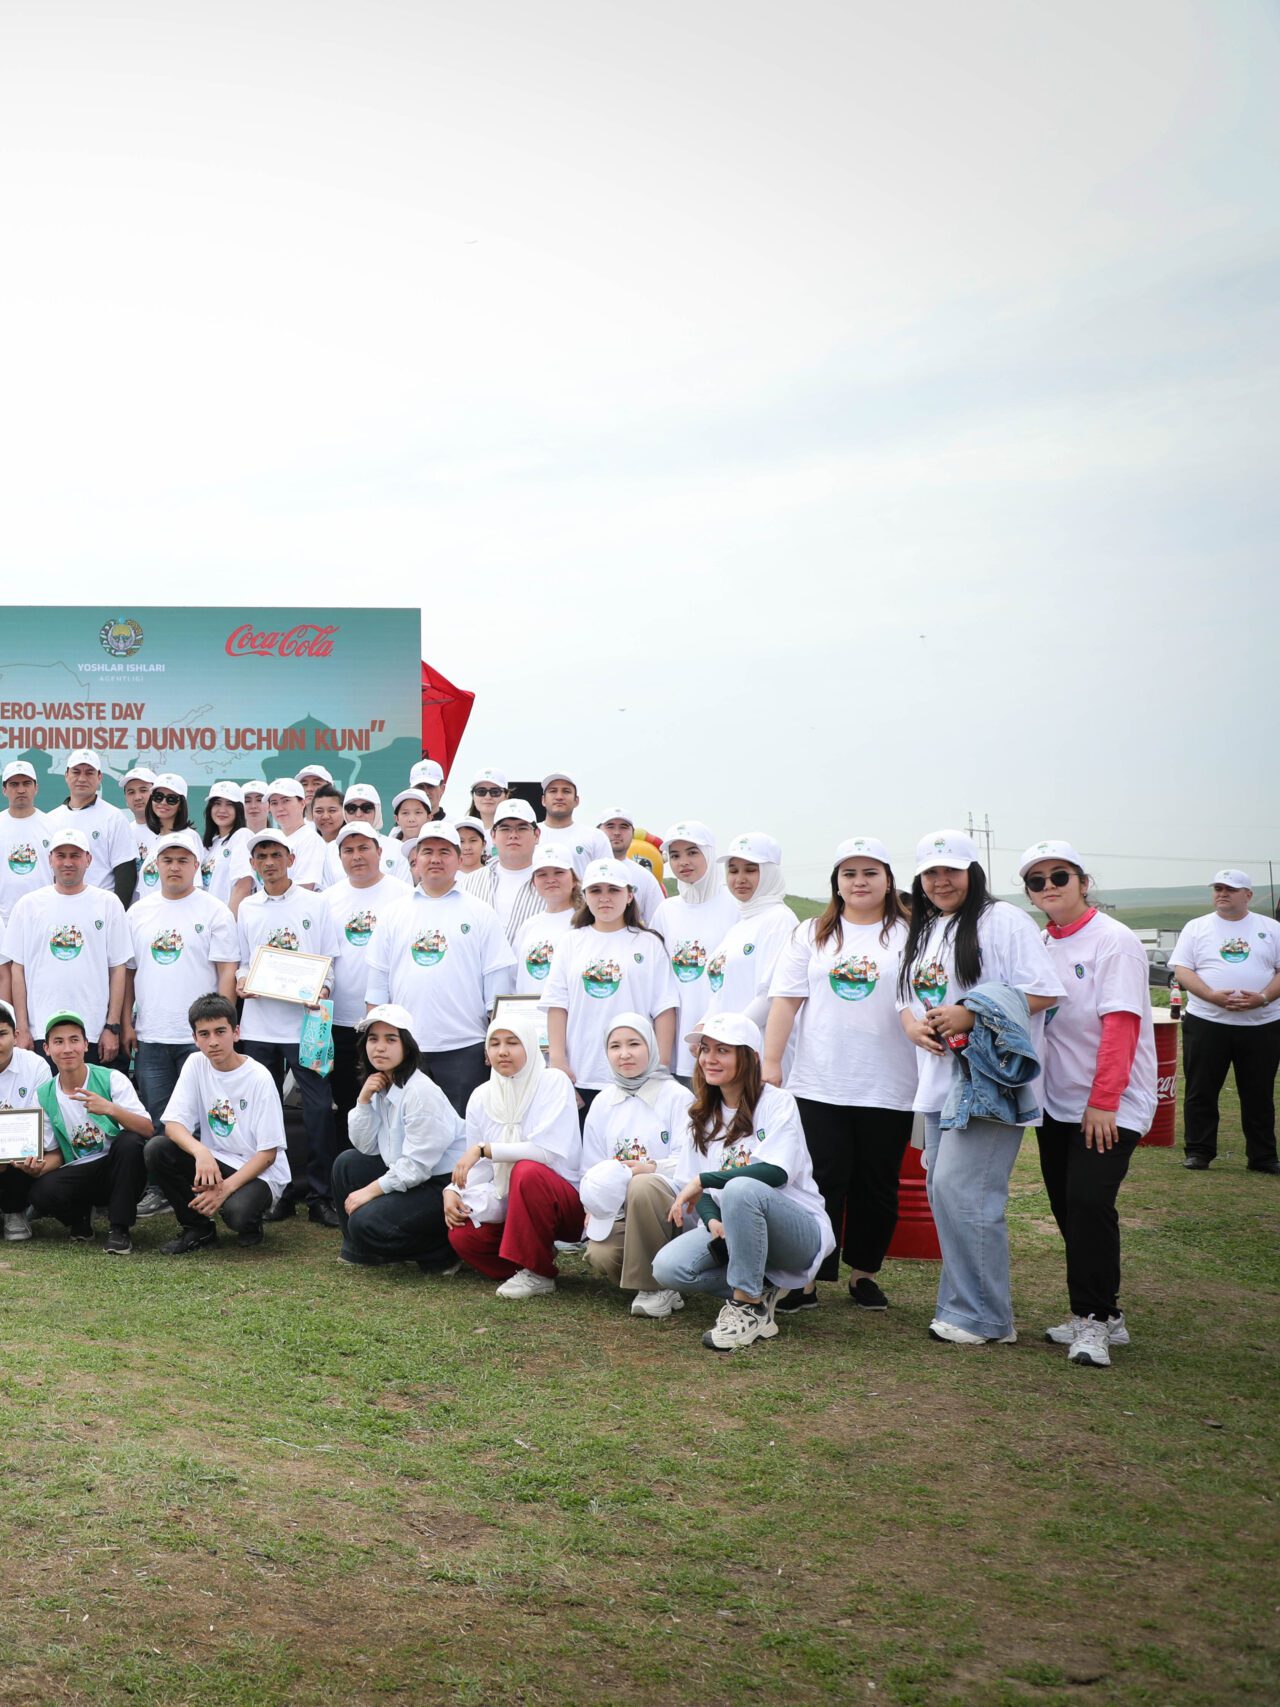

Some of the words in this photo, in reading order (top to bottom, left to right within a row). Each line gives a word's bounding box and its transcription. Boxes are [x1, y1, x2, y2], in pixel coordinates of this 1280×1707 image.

[77, 663, 124, 672] YOSHLAR
[126, 663, 165, 672] ISHLARI
[111, 702, 145, 721] DAY
[136, 727, 217, 751] DUNYO
[224, 728, 306, 751] UCHUN
